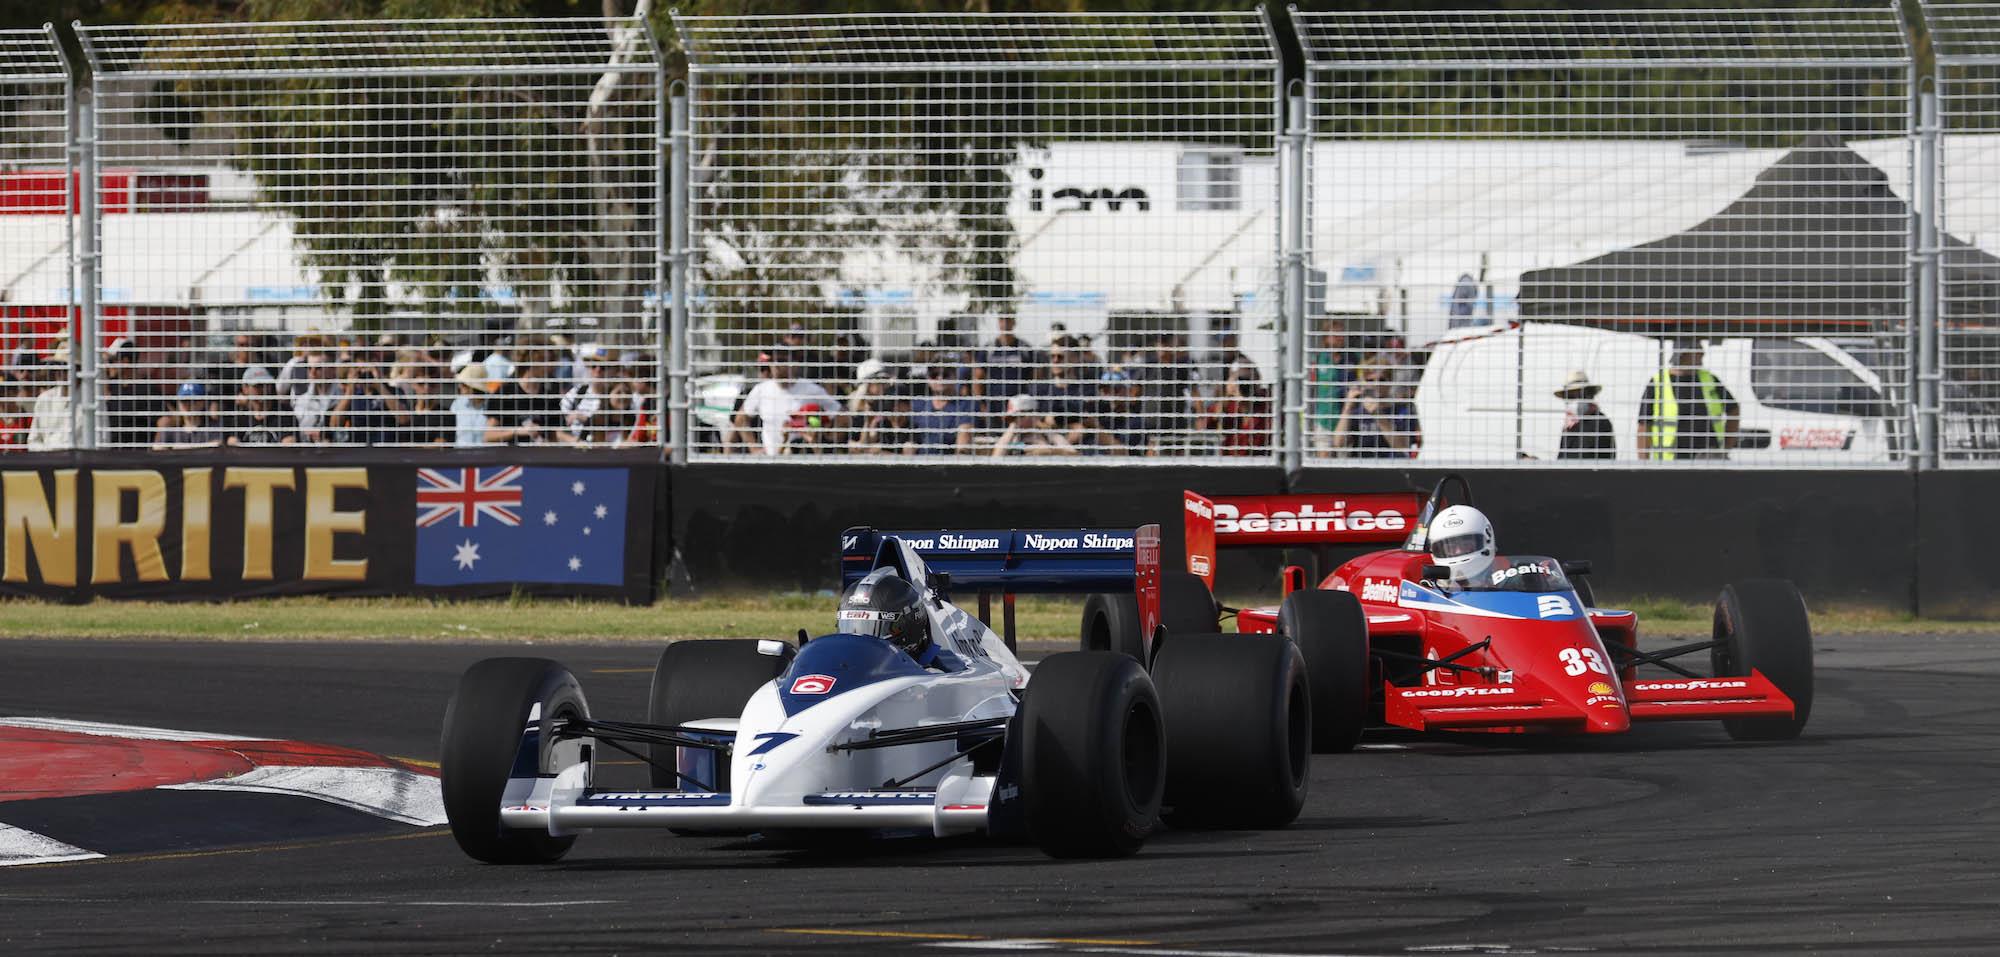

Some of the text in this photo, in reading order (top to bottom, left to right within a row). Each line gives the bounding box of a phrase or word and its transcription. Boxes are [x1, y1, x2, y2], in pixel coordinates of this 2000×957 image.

[1, 467, 368, 586] NRITE
[1213, 501, 1405, 533] Beatrice
[938, 535, 999, 551] Shinpan
[1024, 534, 1078, 551] Nippon
[1361, 578, 1398, 603] Beatrice
[1558, 647, 1609, 677] 33
[1401, 687, 1515, 698] GOODYEAR
[1635, 681, 1747, 690] GOODYEAR
[745, 732, 801, 757] 7
